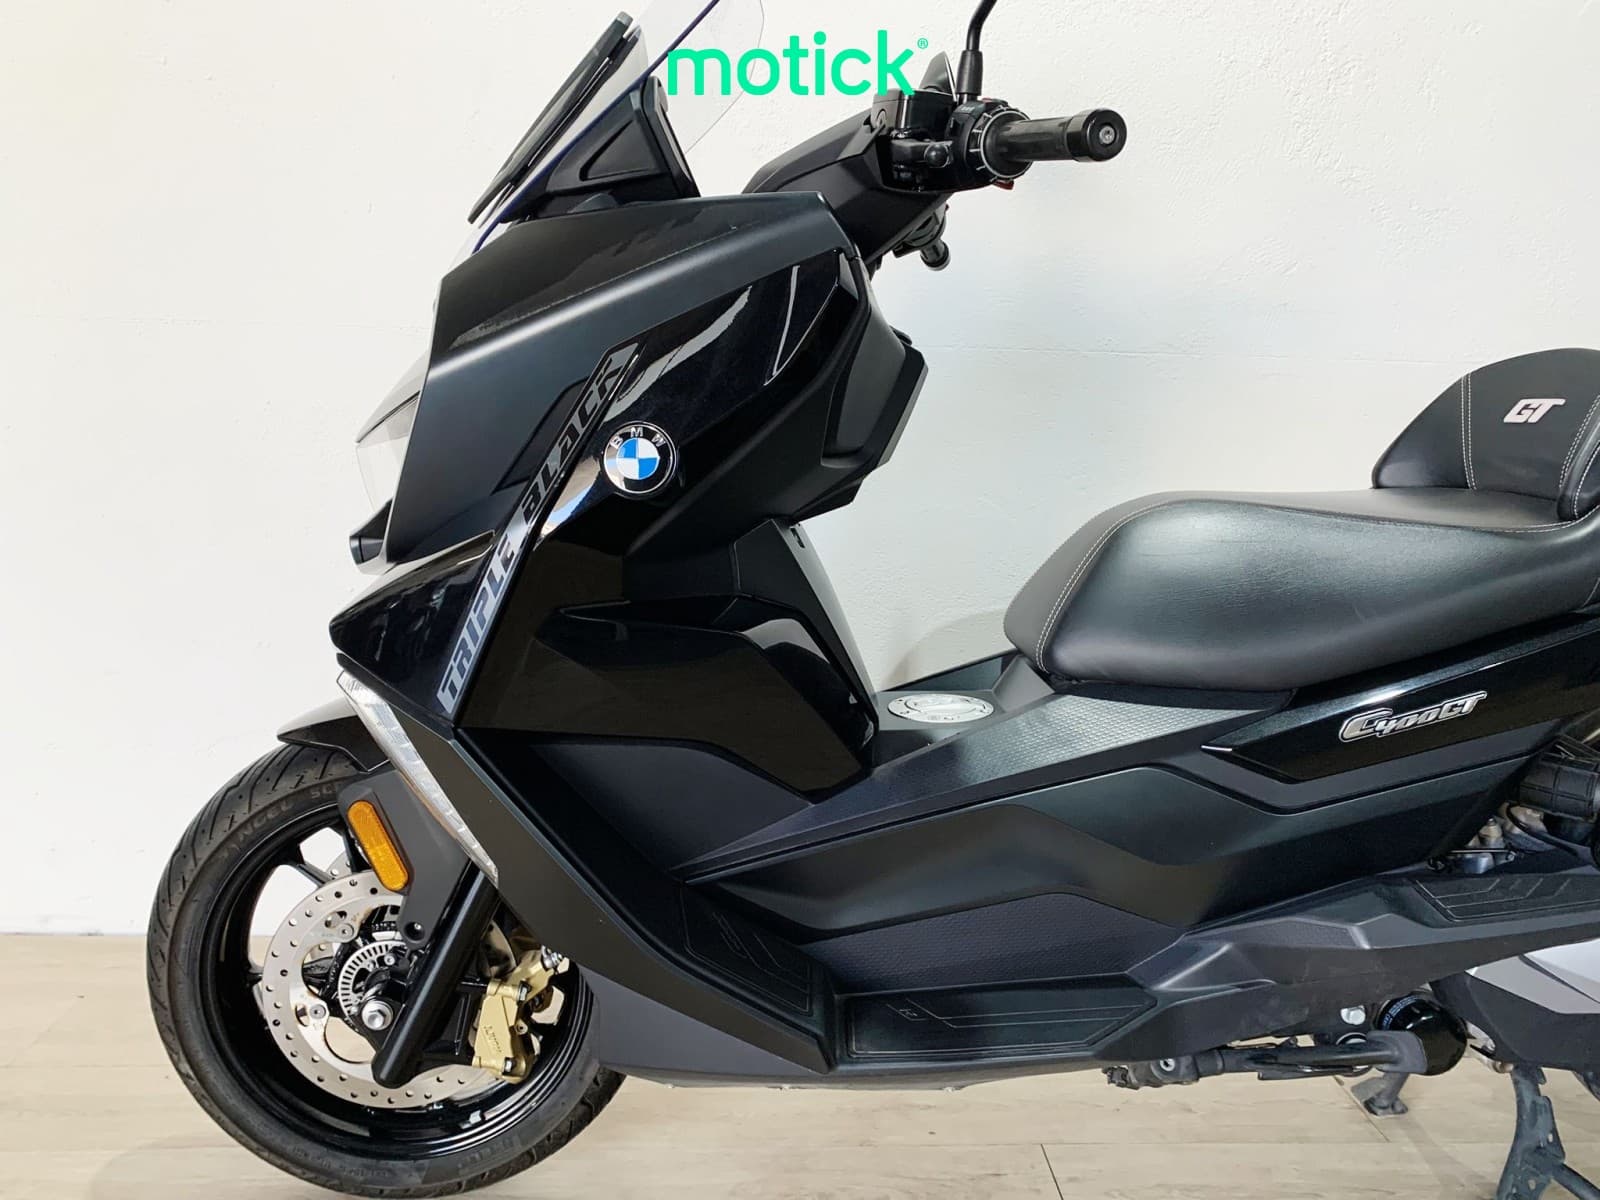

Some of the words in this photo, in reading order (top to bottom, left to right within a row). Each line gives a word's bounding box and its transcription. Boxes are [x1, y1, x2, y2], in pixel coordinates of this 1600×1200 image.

[1503, 398, 1566, 423] GT
[609, 426, 666, 449] BMW
[441, 532, 516, 700] TRIPLE
[521, 357, 625, 525] BLACK
[1338, 690, 1488, 743] C400GT
